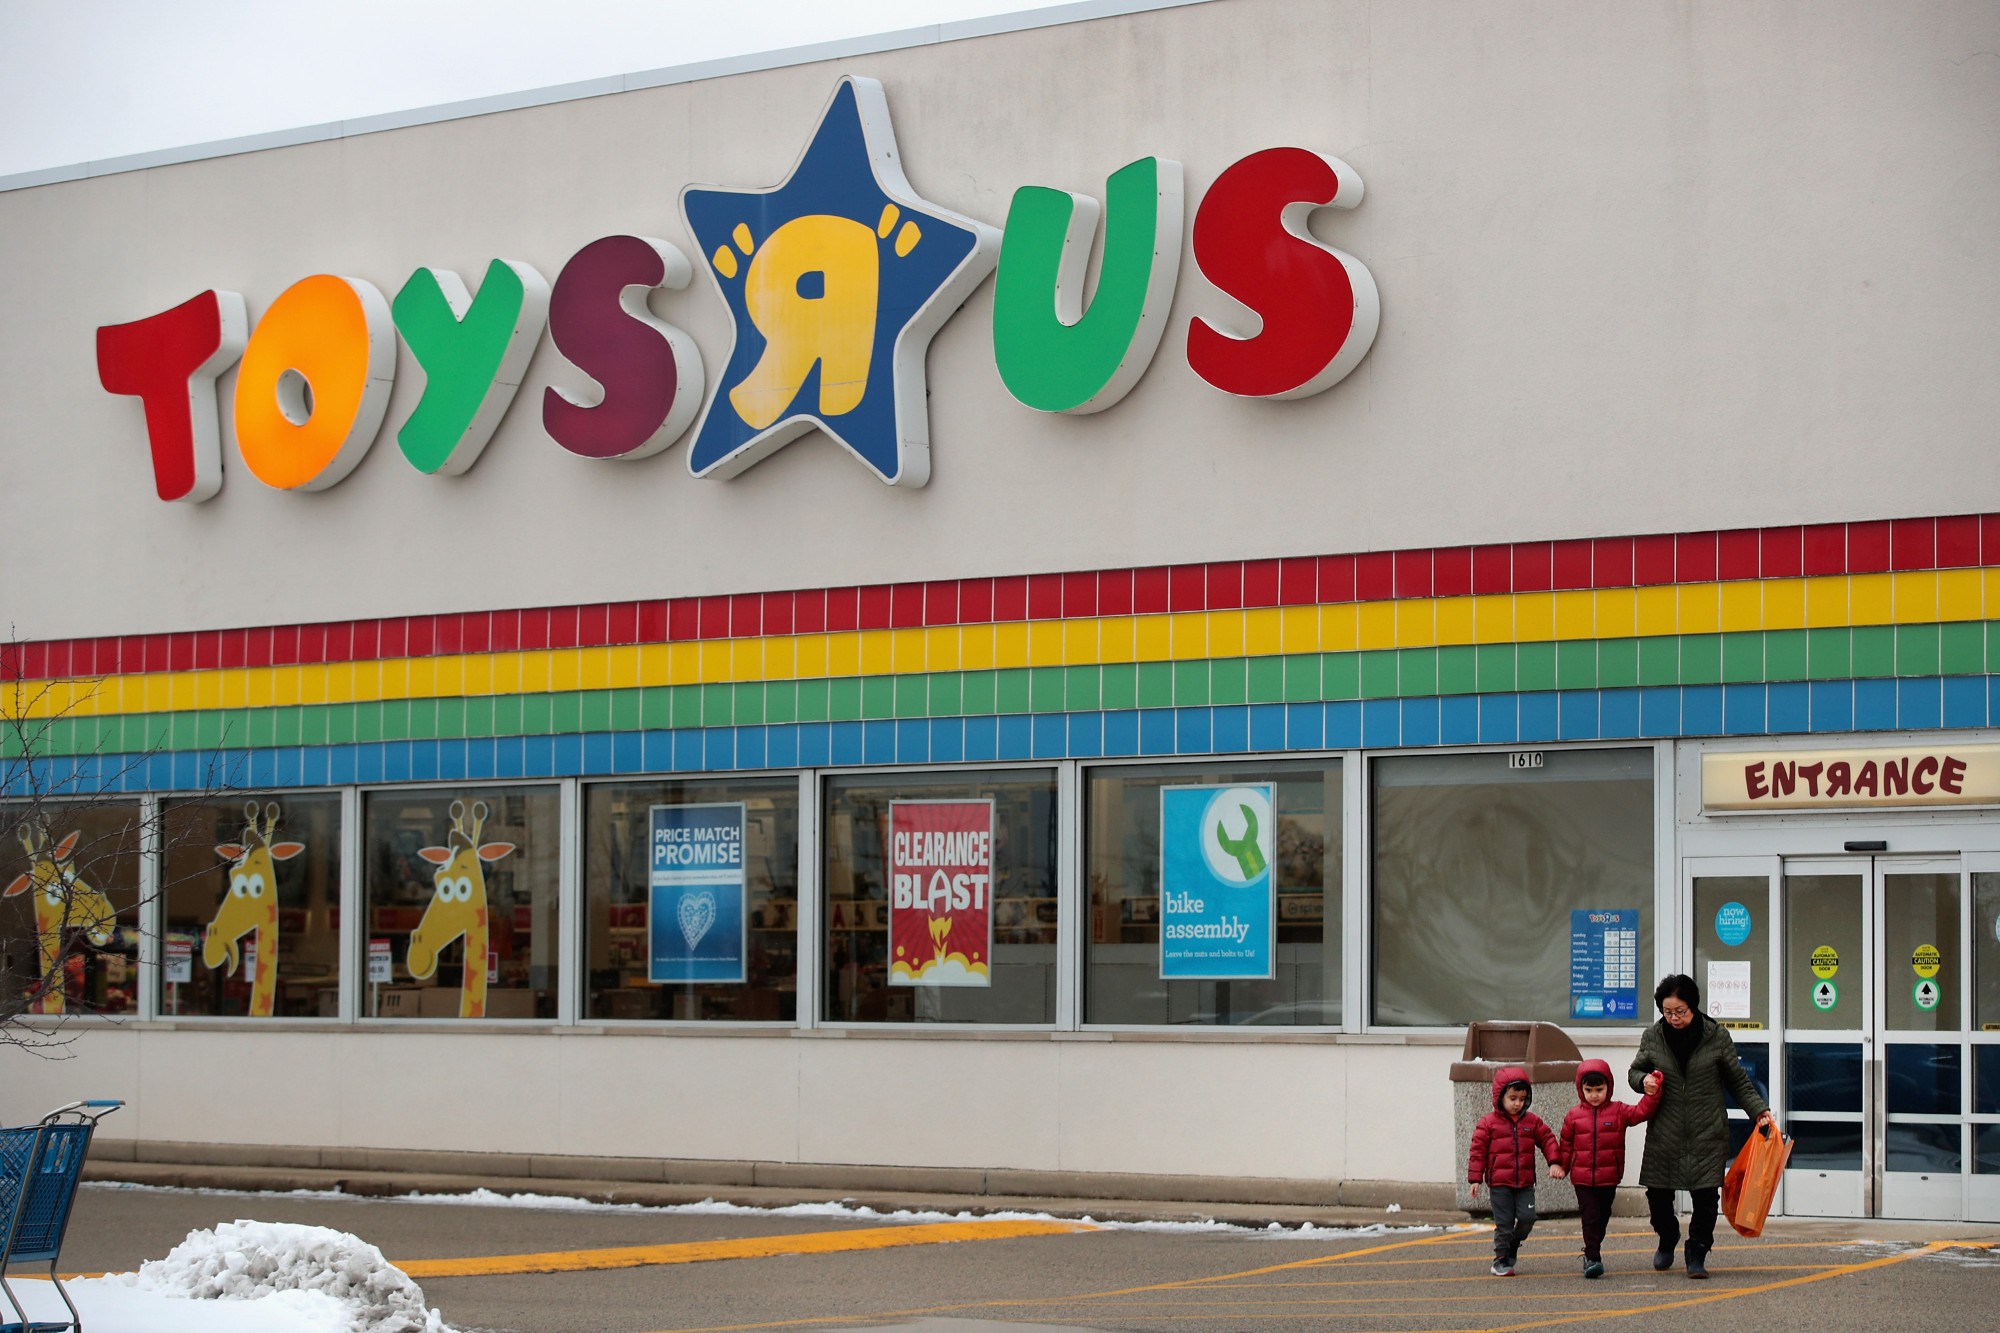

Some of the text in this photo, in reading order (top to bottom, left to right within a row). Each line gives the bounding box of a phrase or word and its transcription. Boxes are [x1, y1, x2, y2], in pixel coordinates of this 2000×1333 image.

[97, 234, 692, 502] TOYS
[992, 146, 1368, 415] US
[1512, 752, 1542, 767] 1610
[1744, 755, 1967, 800] ENTRANCE
[655, 826, 740, 843] PRICE MATCH
[655, 842, 740, 865] PROMISE
[894, 831, 989, 867] CLEARANCE
[894, 868, 989, 913] BLAST
[1165, 891, 1205, 914] bike
[1723, 908, 1744, 916] now
[1166, 916, 1250, 944] assembly
[1719, 914, 1749, 928] hiring!
[1165, 950, 1182, 958] Leave
[1183, 950, 1193, 958] the
